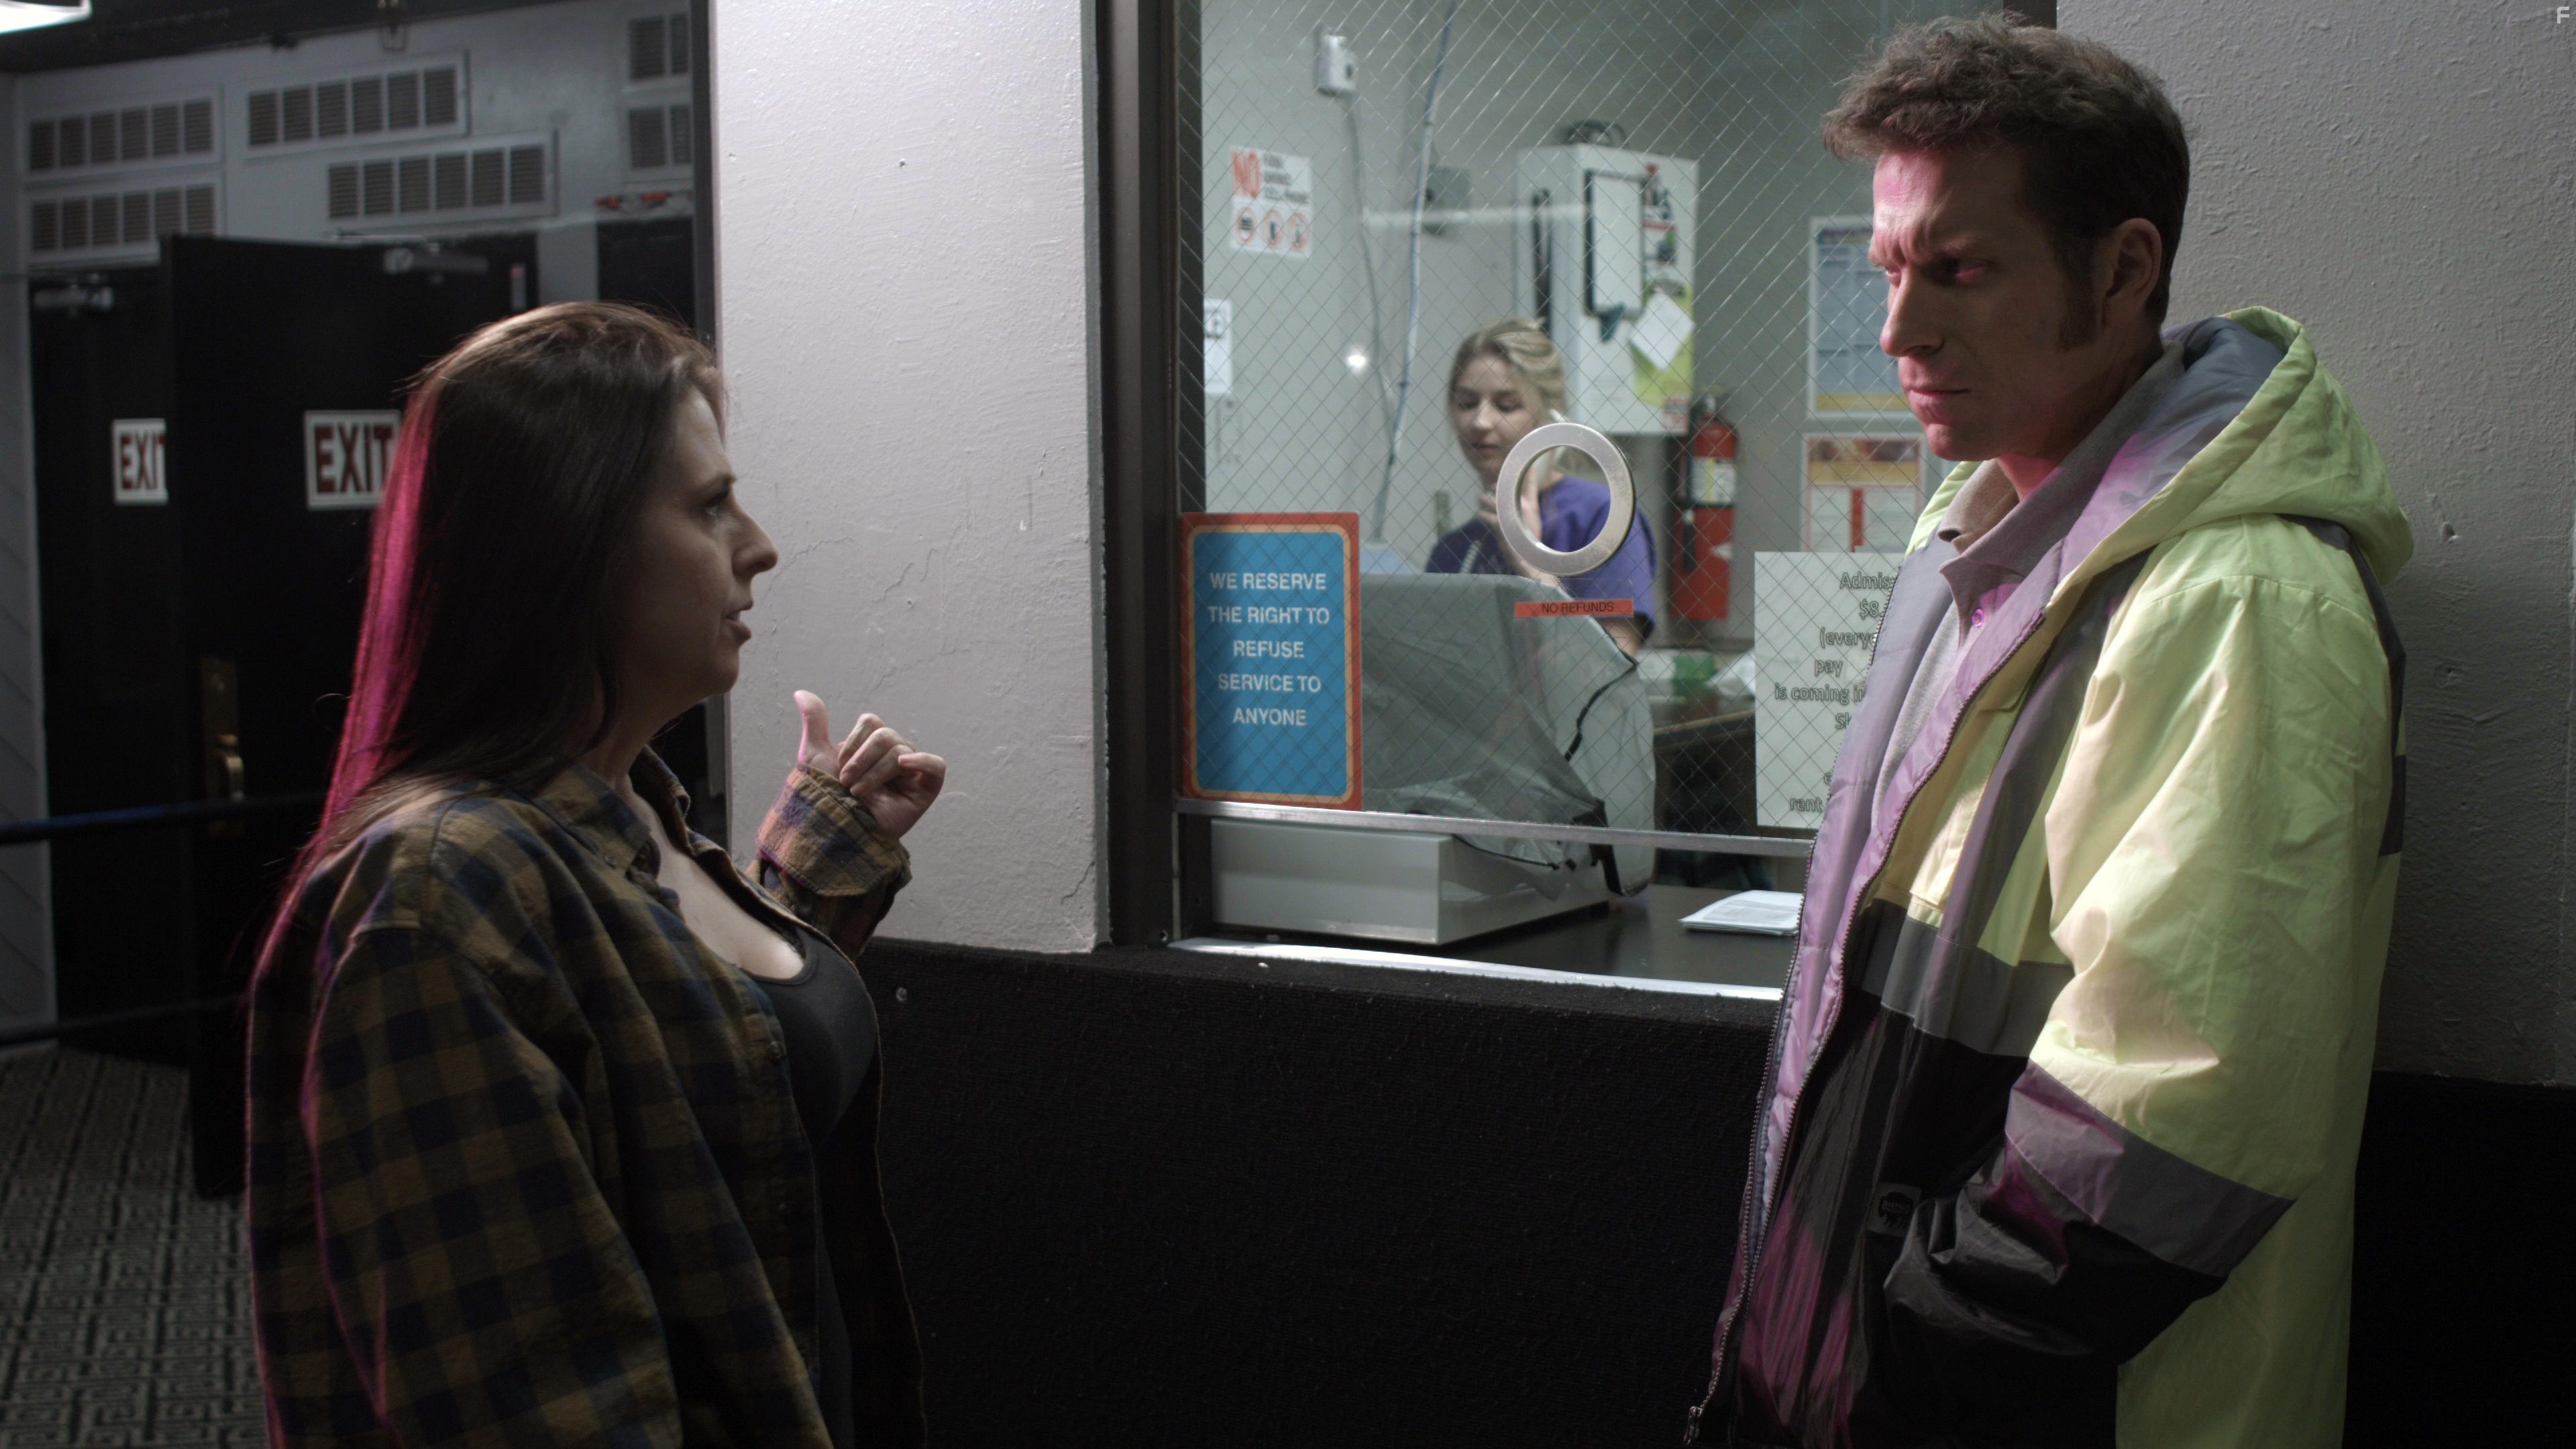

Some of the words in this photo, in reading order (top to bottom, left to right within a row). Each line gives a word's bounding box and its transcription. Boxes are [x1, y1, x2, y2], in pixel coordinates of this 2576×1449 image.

[314, 423, 393, 493] EXIT
[1210, 572, 1238, 590] WE
[1242, 572, 1327, 590] RESERVE
[1208, 606, 1242, 623] THE
[1247, 606, 1302, 624] RIGHT
[1306, 607, 1330, 625] TO
[1542, 603, 1558, 614] NO
[1561, 600, 1615, 613] REFUNDS
[1233, 640, 1305, 659] REFUSE
[1814, 659, 1843, 678] pay
[1218, 673, 1293, 692] SERVICE
[1297, 675, 1322, 693] TO
[1774, 682, 1787, 700] is
[1790, 684, 1850, 706] coming
[1233, 707, 1307, 727] ANYONE
[1789, 796, 1823, 814] rent
